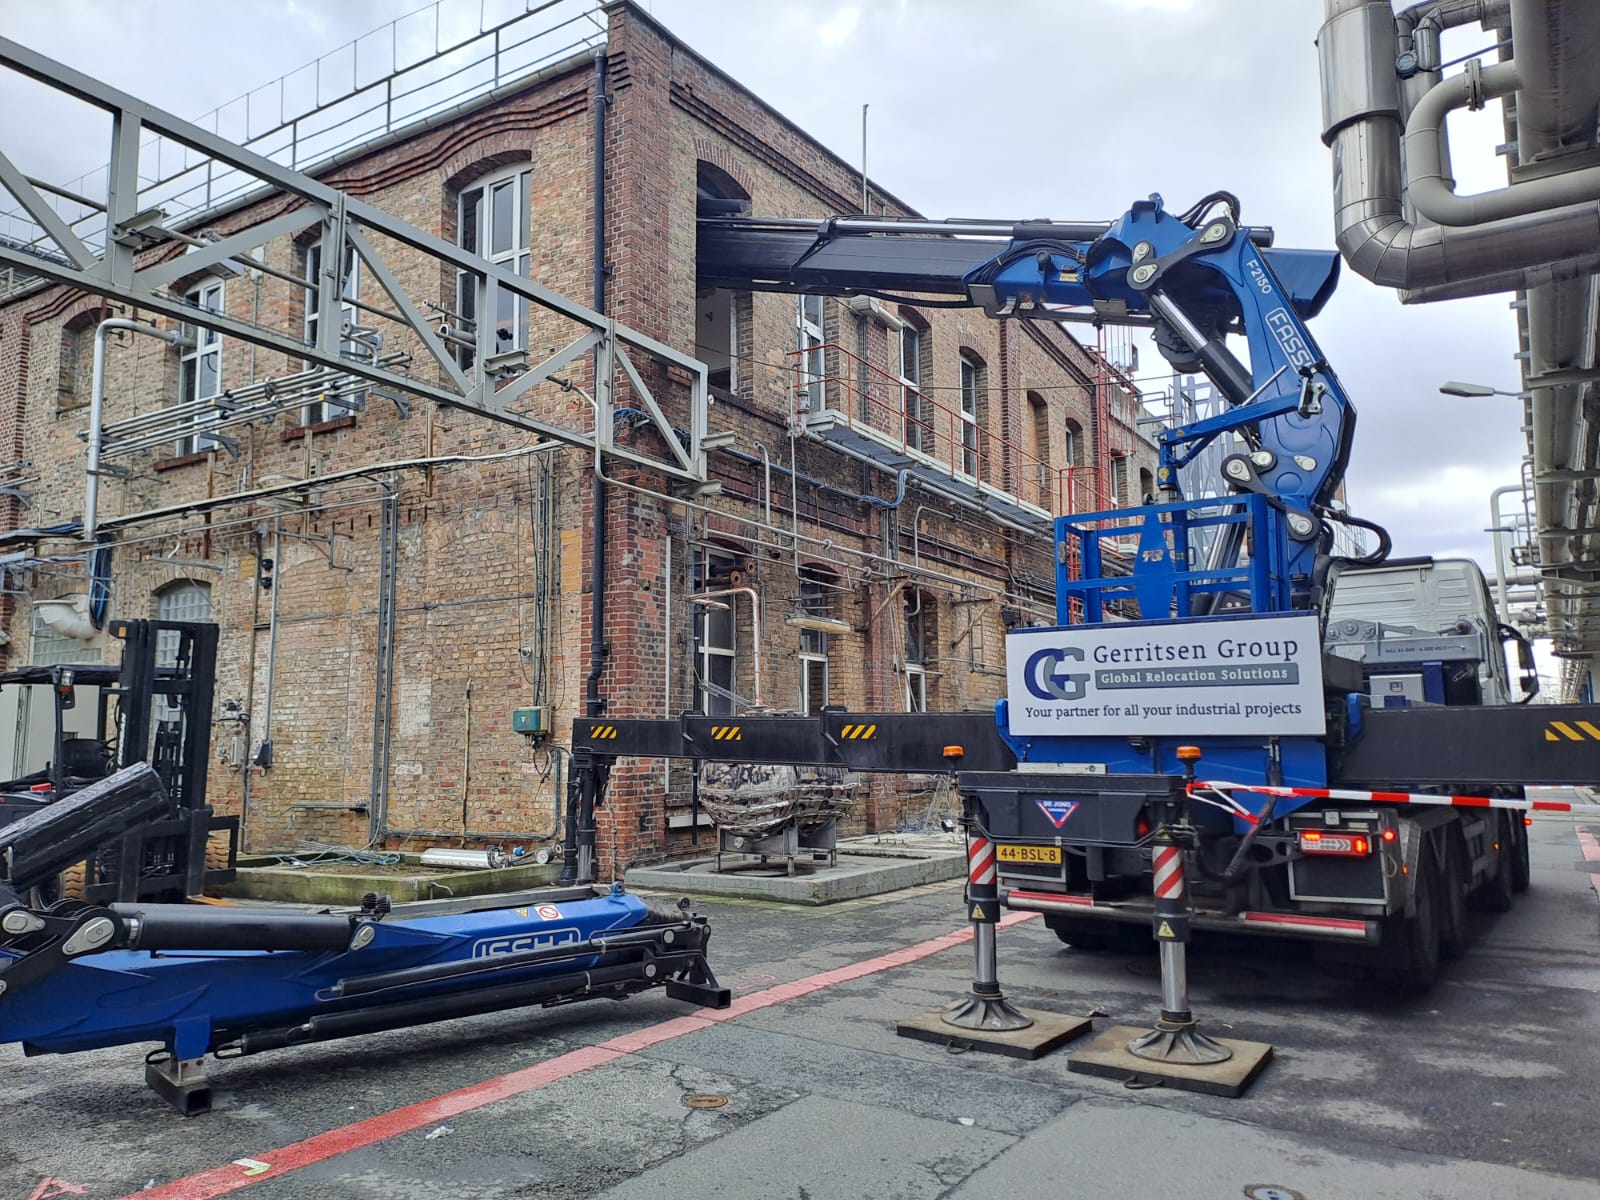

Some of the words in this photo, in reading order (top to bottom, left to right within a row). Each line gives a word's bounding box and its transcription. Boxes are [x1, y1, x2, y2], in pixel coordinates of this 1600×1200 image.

[1246, 259, 1272, 294] F2150
[1093, 642, 1207, 664] Gerritsen
[1217, 639, 1298, 662] Group
[1101, 672, 1141, 684] Global
[1146, 670, 1216, 683] Relocation
[1221, 668, 1288, 681] Solutions
[1025, 706, 1053, 718] Your
[1056, 705, 1100, 720] partner
[1103, 704, 1121, 717] for
[1124, 704, 1139, 716] all
[1142, 706, 1172, 720] your
[1176, 702, 1240, 716] industrial
[1244, 701, 1302, 718] projects
[1001, 848, 1057, 861] 44-BSL-8
